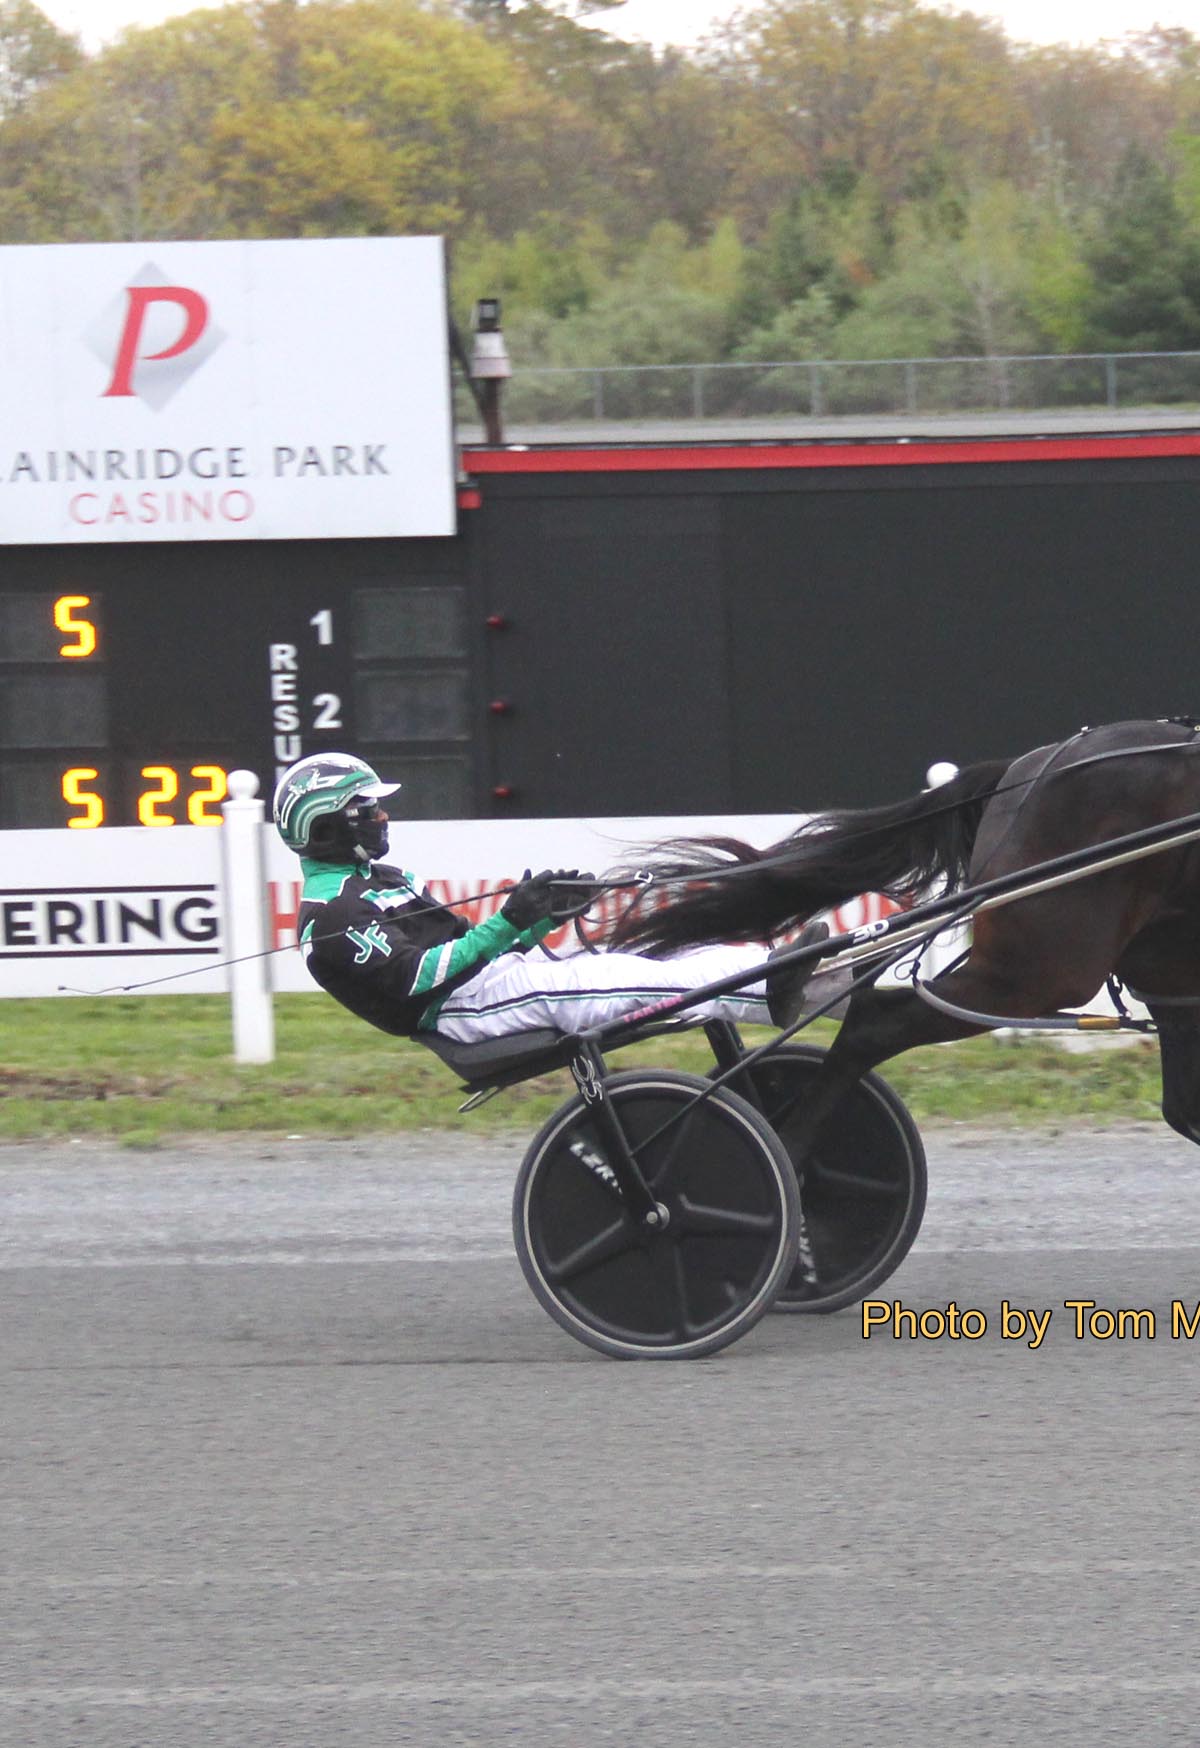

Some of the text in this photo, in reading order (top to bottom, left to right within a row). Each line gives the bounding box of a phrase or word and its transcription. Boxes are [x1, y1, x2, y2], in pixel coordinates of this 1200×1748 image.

[0, 444, 390, 483] AINRIDGE PARK
[68, 489, 256, 525] CASINO
[53, 595, 97, 658] 5
[310, 609, 334, 645] 1
[312, 693, 343, 729] 2
[62, 767, 104, 830] 5
[3, 897, 219, 946] ERING
